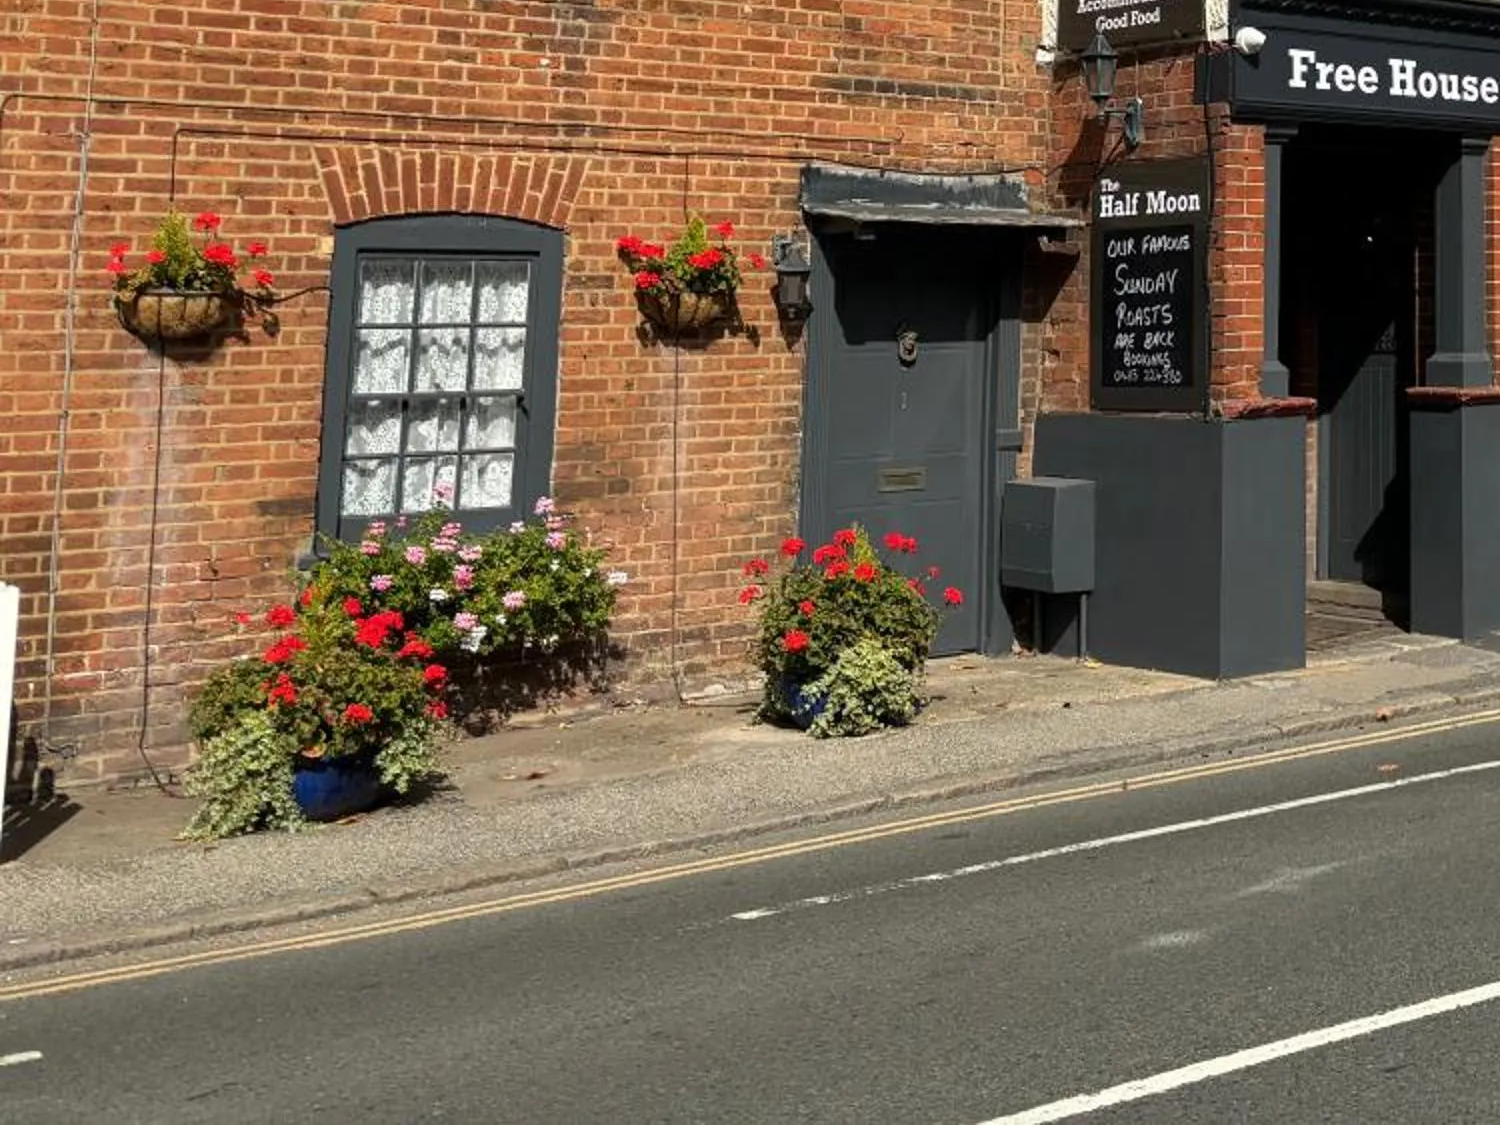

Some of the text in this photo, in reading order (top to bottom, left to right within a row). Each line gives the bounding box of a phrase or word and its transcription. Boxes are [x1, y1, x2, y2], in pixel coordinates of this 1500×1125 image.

[1095, 6, 1161, 32] Good Food
[1288, 48, 1500, 104] Free House
[1101, 178, 1120, 192] The
[1100, 191, 1200, 218] Half Moon
[1107, 235, 1190, 258] OUR FAMOUS
[1116, 301, 1173, 329] ROASTS
[1113, 331, 1175, 350] ARE BACK
[1123, 348, 1171, 368] BOOKINGS
